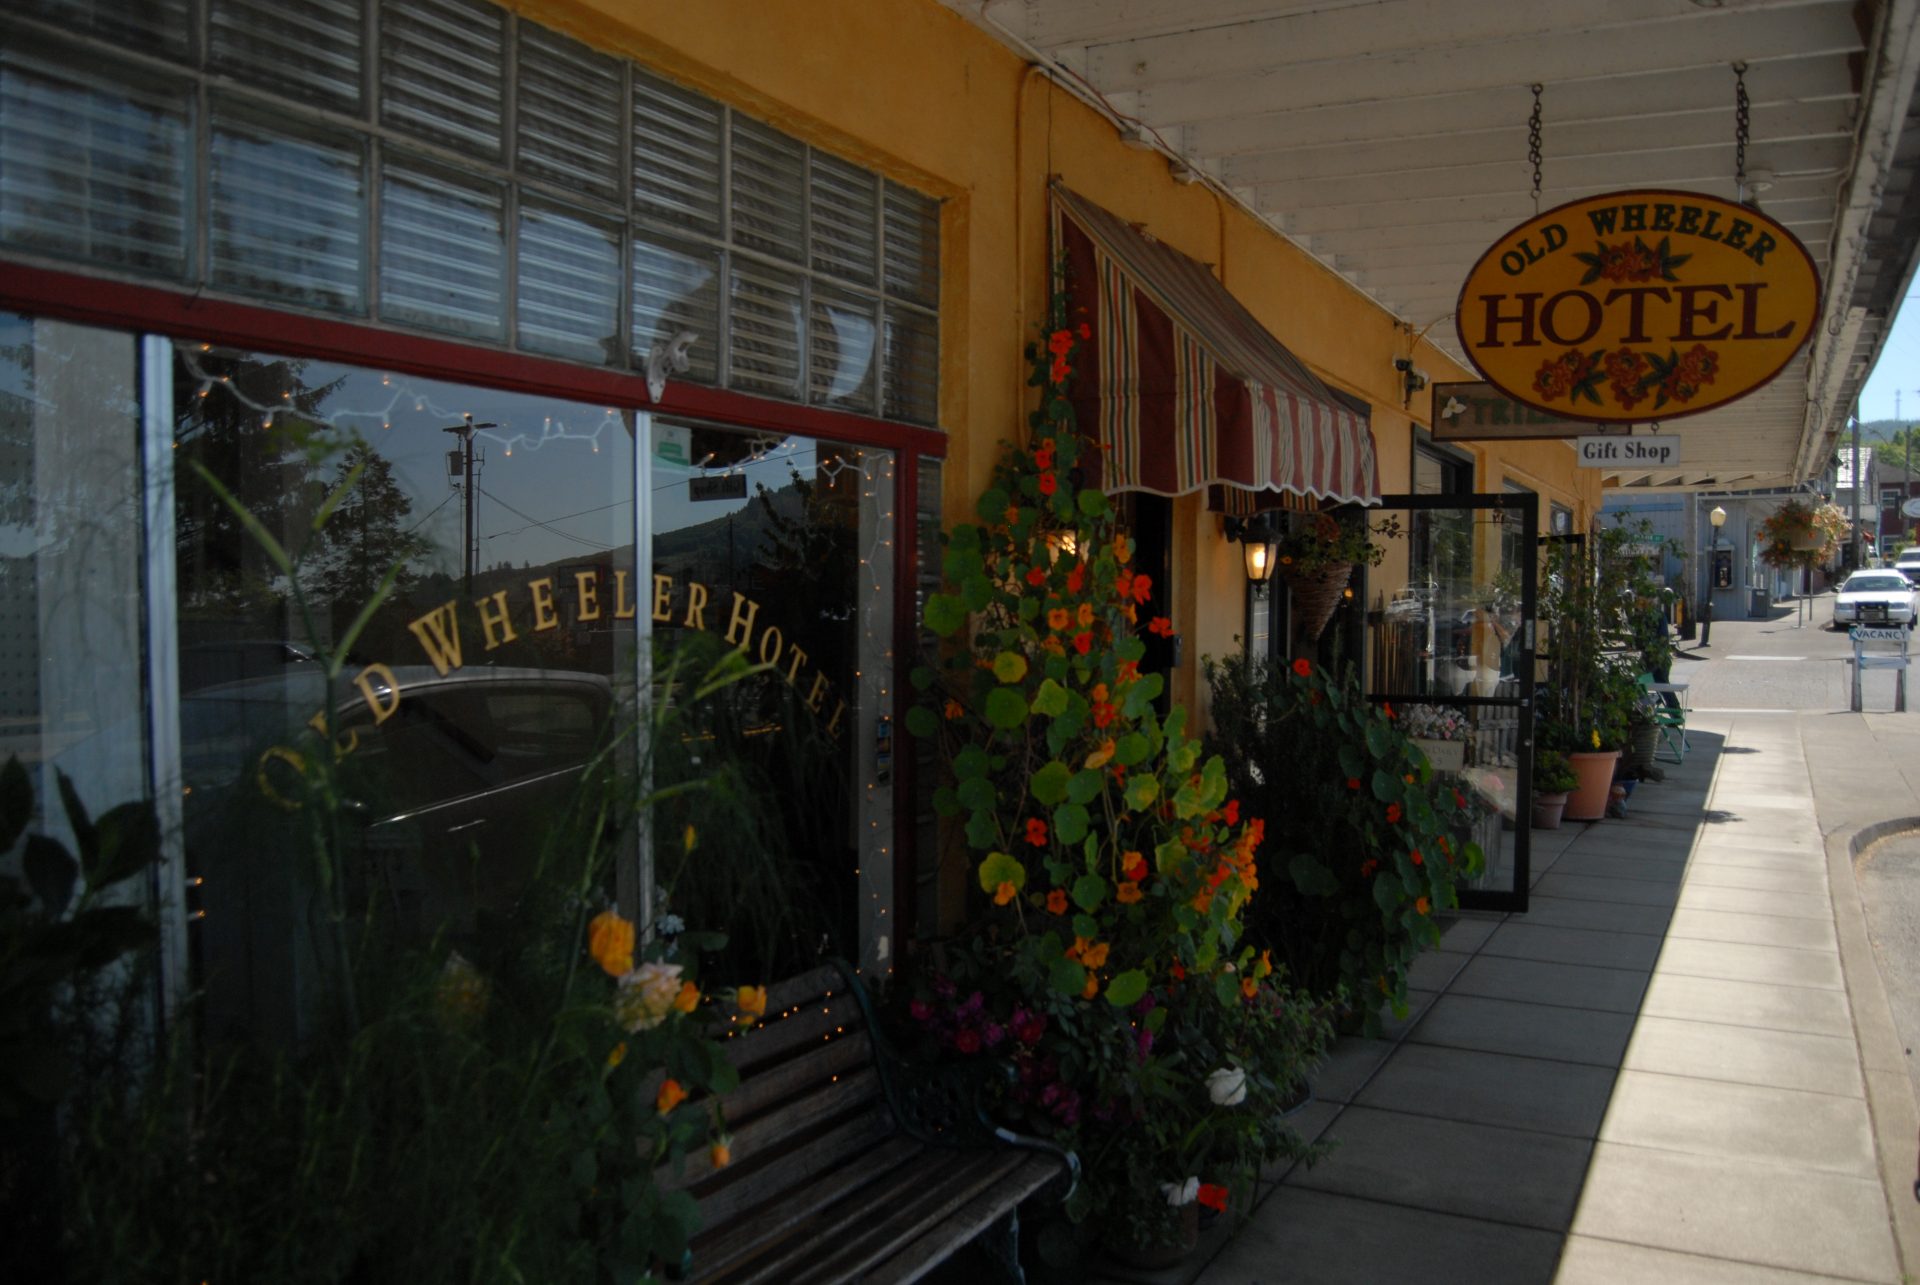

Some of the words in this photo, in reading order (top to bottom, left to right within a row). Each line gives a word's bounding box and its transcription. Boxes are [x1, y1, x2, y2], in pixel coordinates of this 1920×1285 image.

[1500, 223, 1568, 276] OLD
[1588, 203, 1777, 266] WHEELER
[1476, 282, 1797, 348] HOTEL
[1583, 441, 1617, 460] Gift
[1624, 441, 1671, 463] Shop
[407, 570, 710, 677] WHEELER
[724, 591, 846, 739] HOTEL
[1855, 630, 1906, 640] VACANCY
